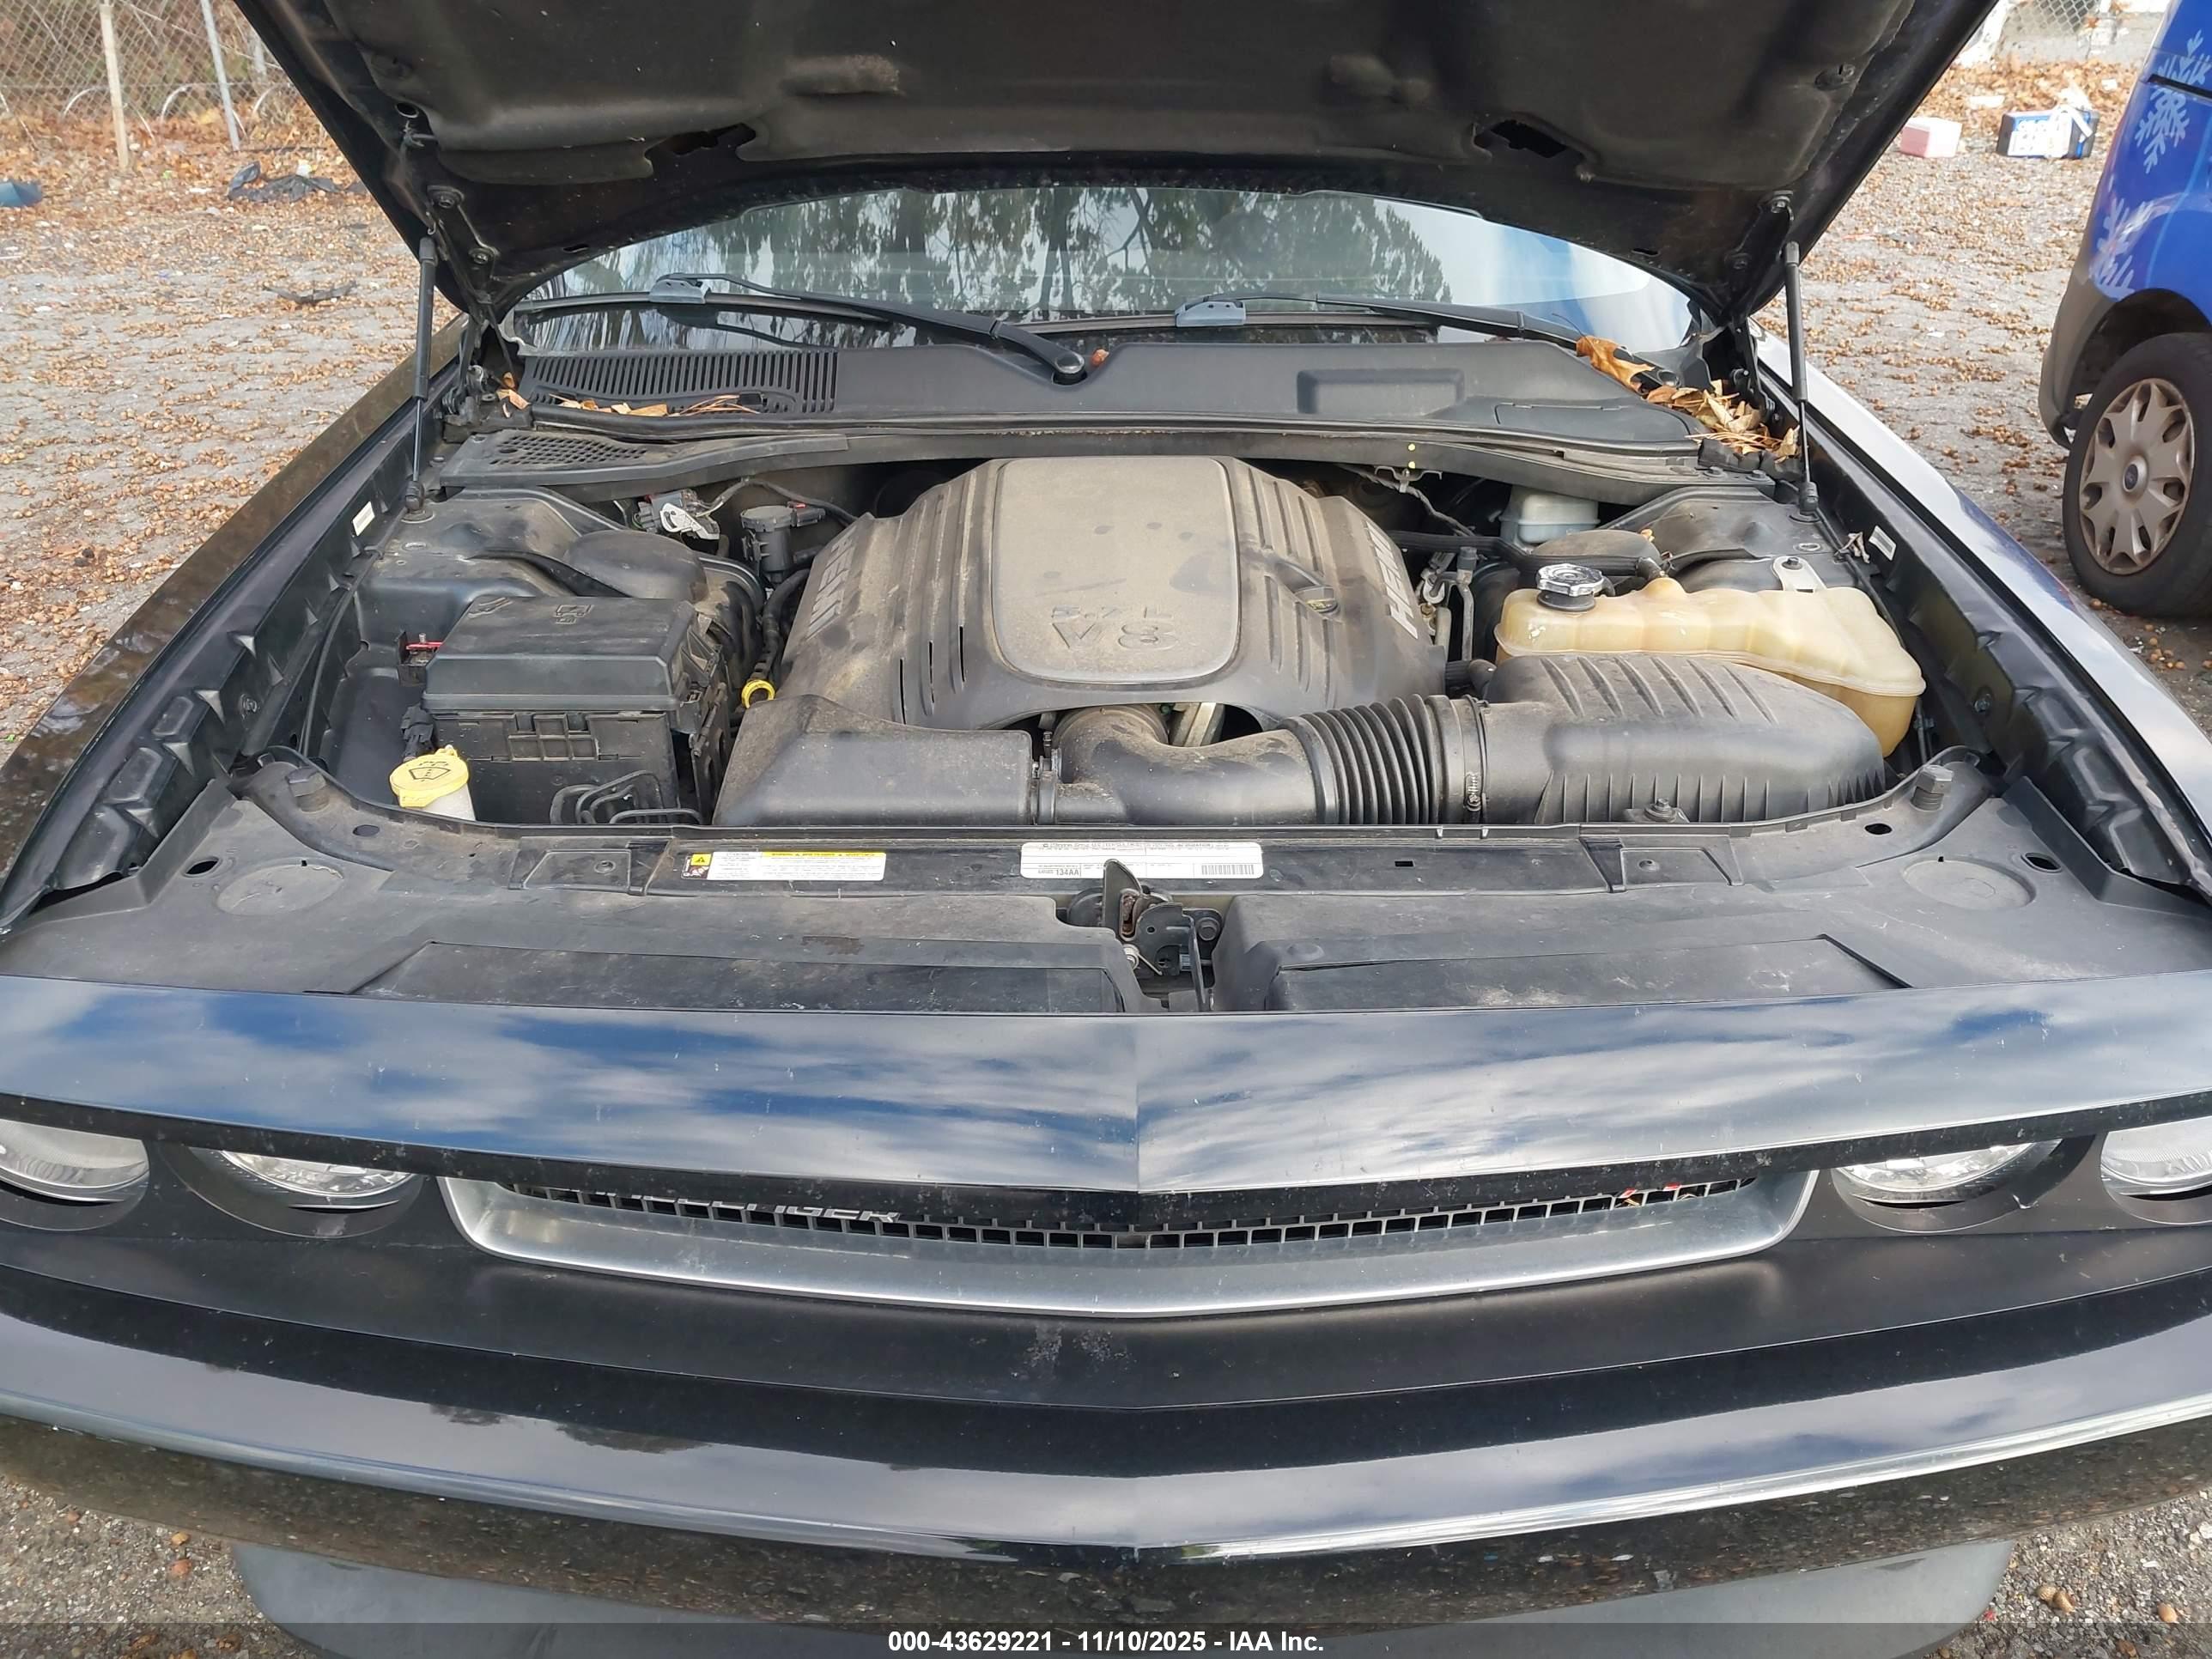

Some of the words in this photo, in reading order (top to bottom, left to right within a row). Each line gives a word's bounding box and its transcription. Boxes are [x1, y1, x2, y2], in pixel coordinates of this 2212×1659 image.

[806, 525, 858, 641] HEMI
[1050, 621, 1180, 650] V8
[1364, 520, 1418, 639] HEMI
